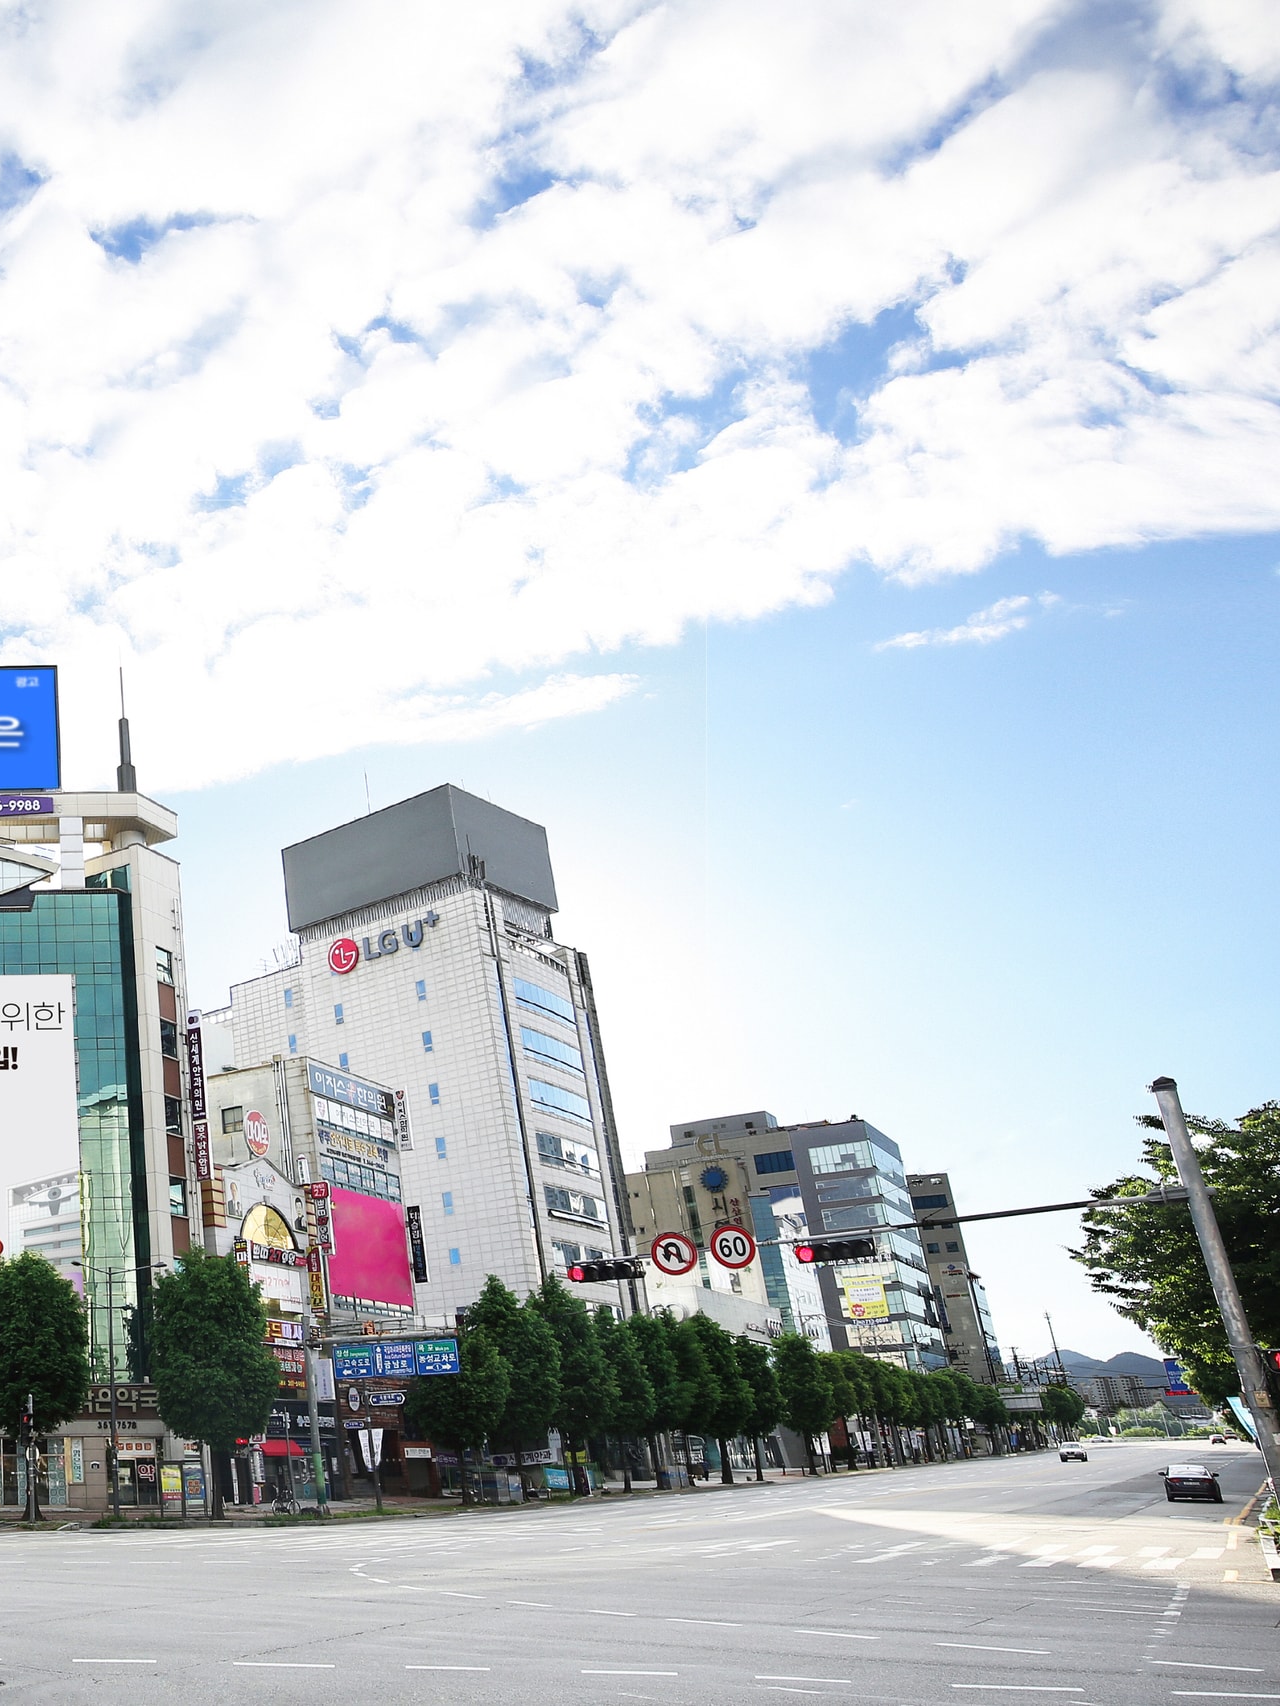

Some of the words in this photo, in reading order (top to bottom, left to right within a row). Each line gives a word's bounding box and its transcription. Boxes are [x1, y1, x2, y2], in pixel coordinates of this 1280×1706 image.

[16, 676, 39, 687] 광고
[1, 1001, 66, 1031] 위한
[189, 1032, 206, 1111] 신세계안과의원
[313, 1189, 326, 1197] 2.7
[720, 1236, 746, 1258] 60
[345, 1359, 370, 1367] 고속도로
[419, 1354, 456, 1363] 농성교차로
[384, 1360, 408, 1369] 금남로
